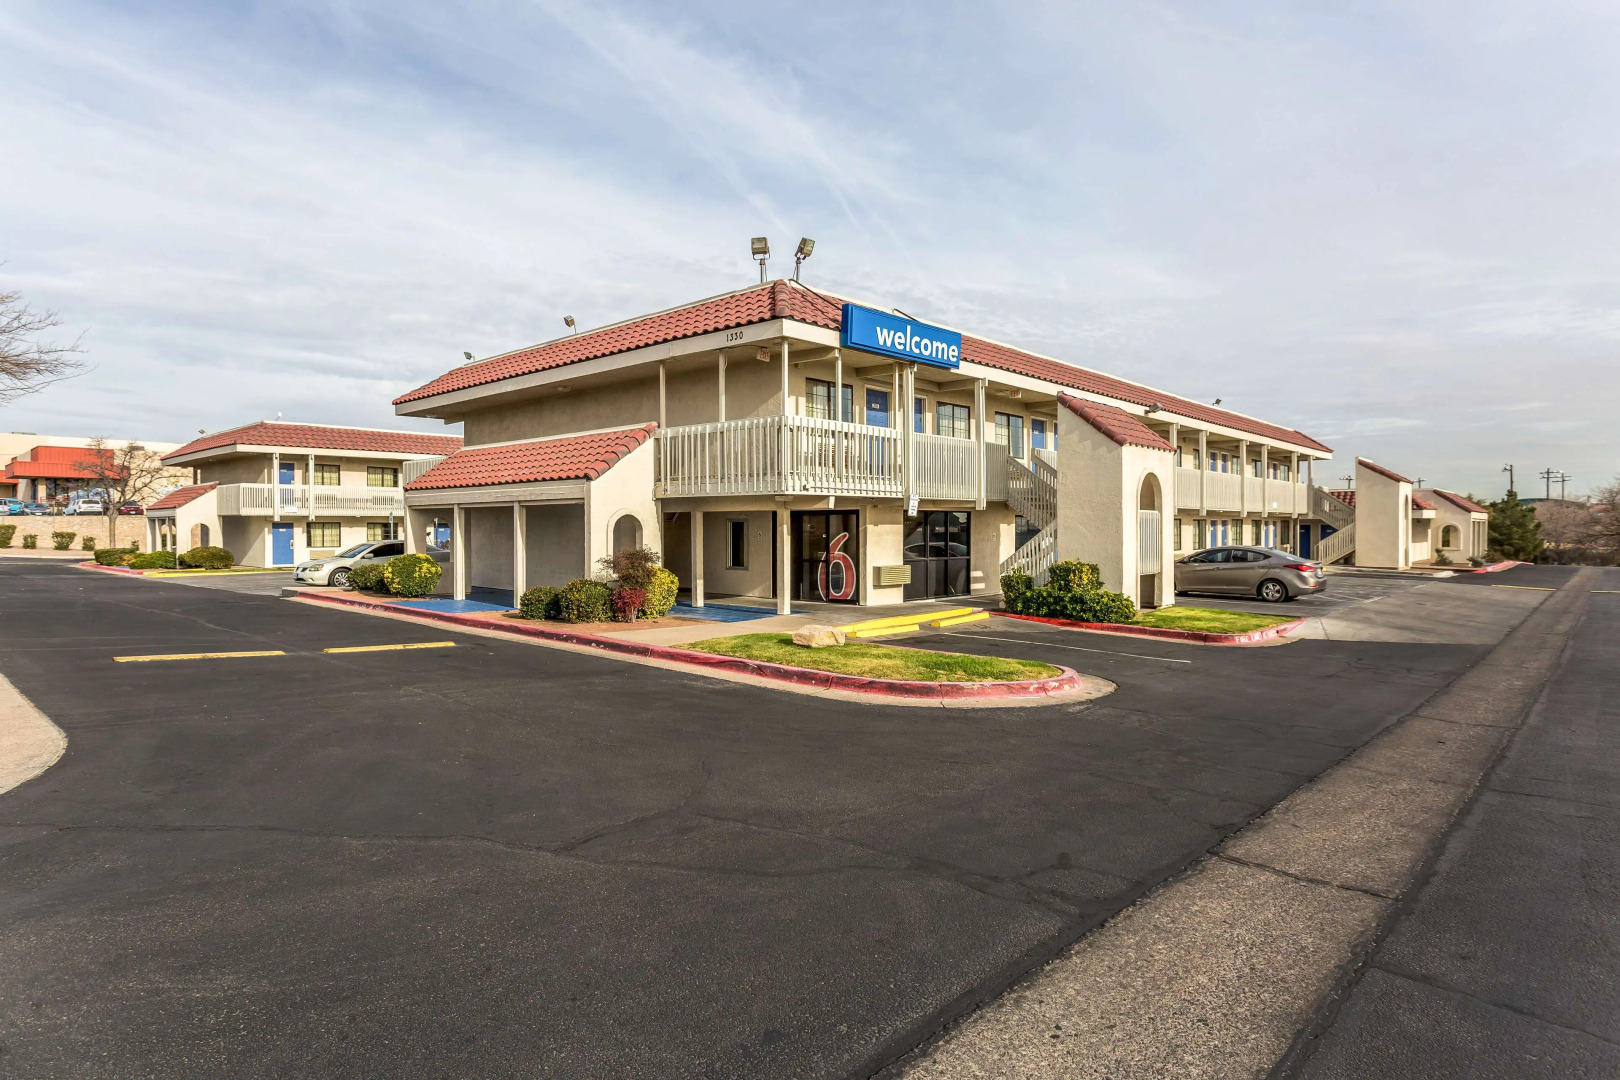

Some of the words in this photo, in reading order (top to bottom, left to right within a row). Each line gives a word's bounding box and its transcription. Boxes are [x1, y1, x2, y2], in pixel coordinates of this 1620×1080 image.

[726, 331, 744, 342] 1330
[876, 325, 959, 362] welcome
[818, 532, 856, 601] 6
